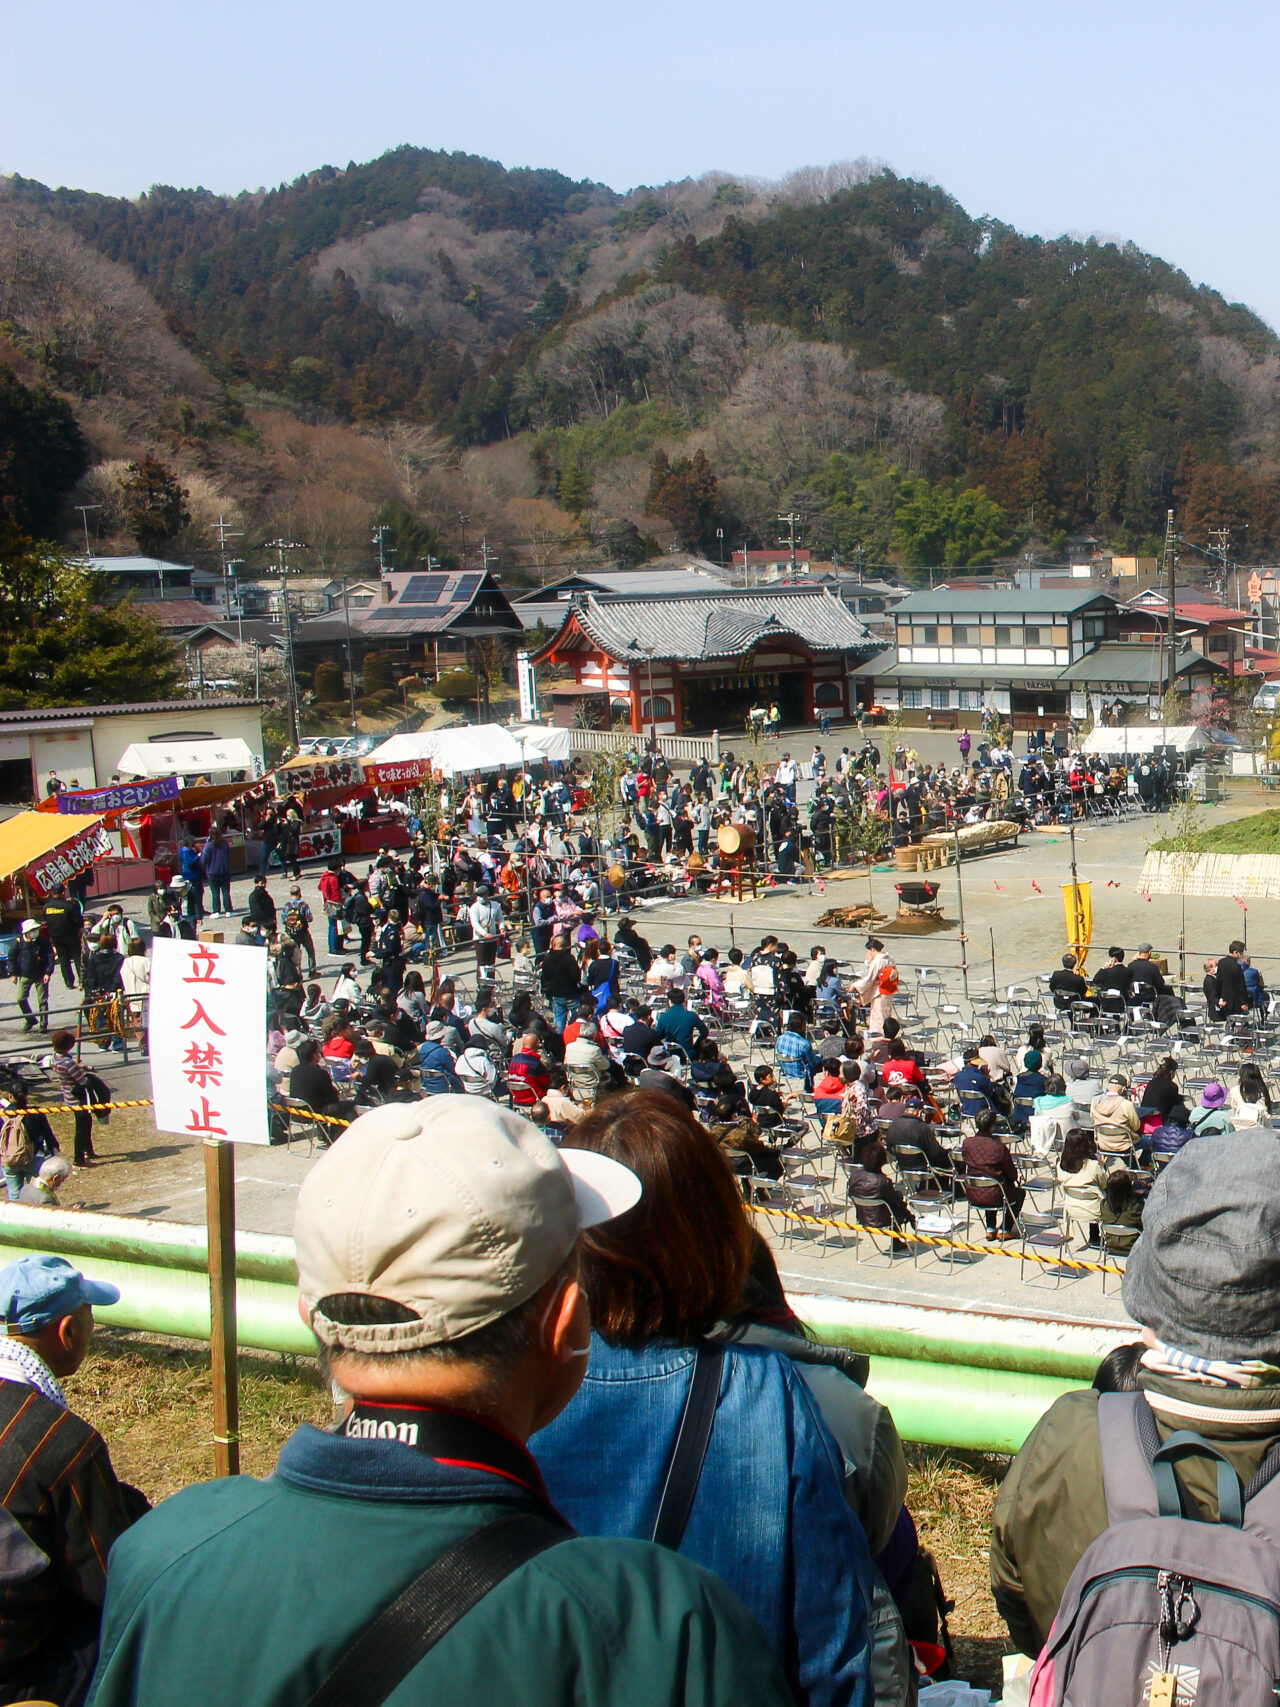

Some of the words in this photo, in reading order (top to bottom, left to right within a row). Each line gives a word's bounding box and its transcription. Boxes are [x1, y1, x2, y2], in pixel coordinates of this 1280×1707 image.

[180, 943, 228, 1136] 立入禁止
[345, 1411, 419, 1446] Canon
